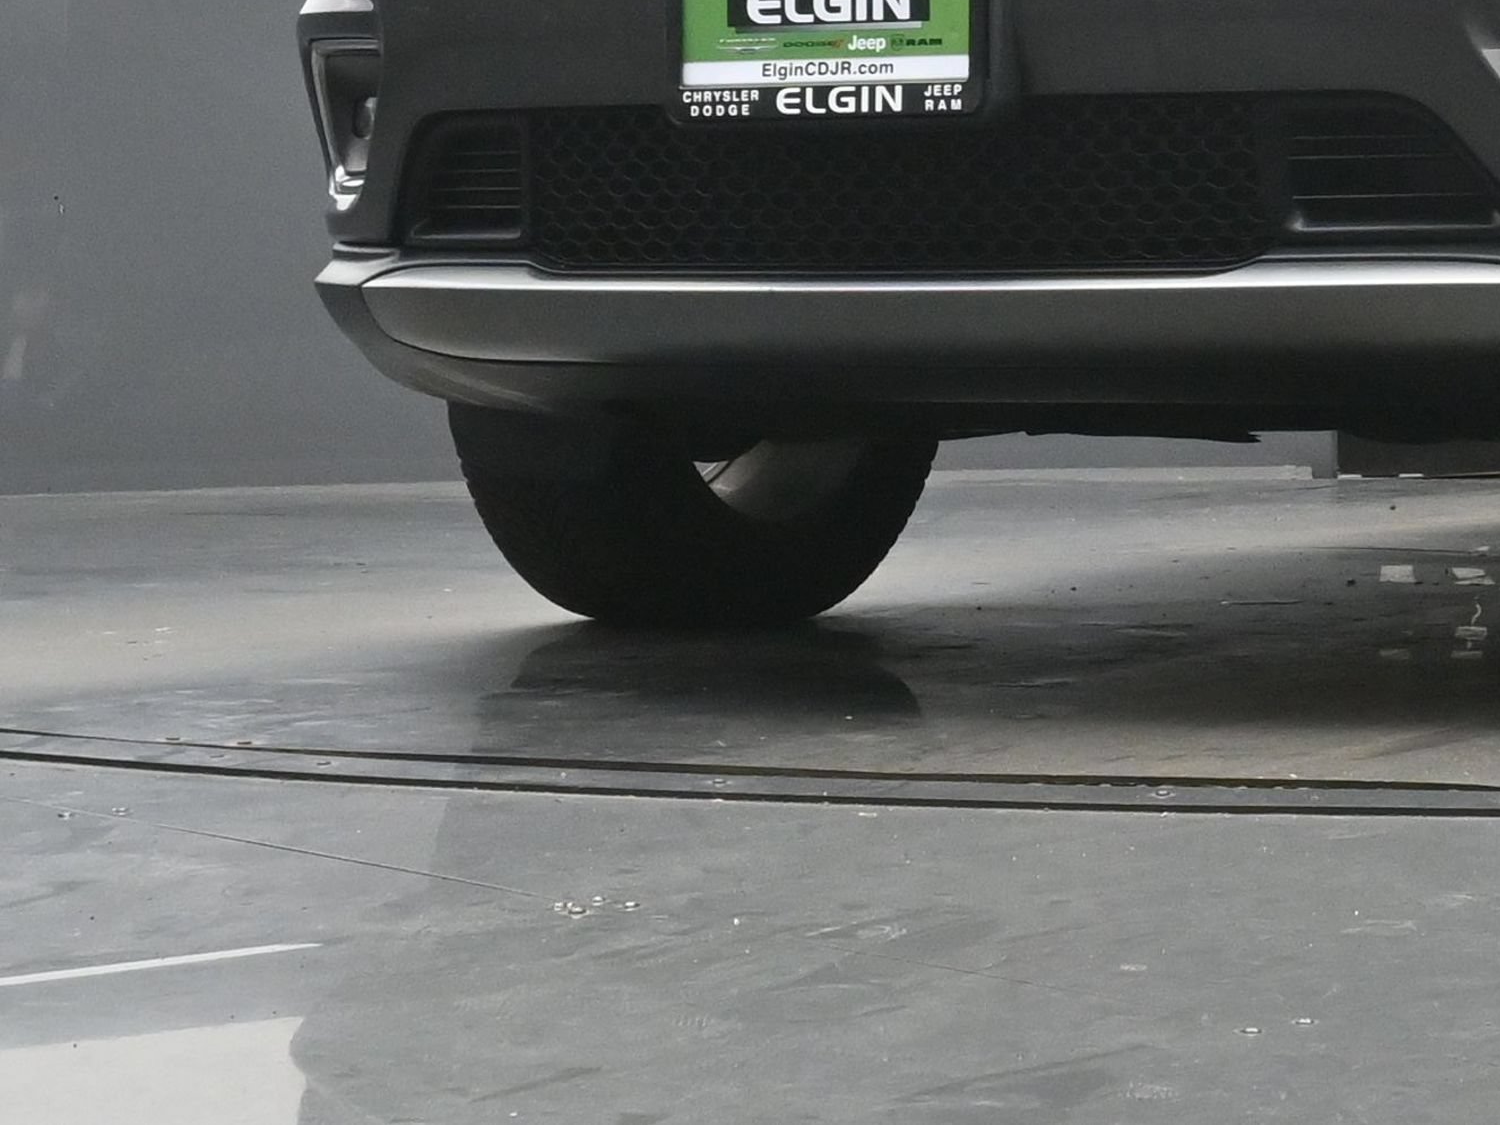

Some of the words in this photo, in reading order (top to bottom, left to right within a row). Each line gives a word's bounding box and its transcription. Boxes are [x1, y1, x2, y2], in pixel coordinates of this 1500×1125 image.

[847, 35, 887, 53] Jeep
[905, 38, 943, 47] RAM
[761, 60, 894, 80] ElginCDJR.com
[682, 89, 760, 104] CHRYSLER
[923, 83, 963, 98] JEEP
[775, 85, 903, 115] ELGIN
[924, 98, 963, 111] RAM
[690, 104, 751, 117] DODGE
